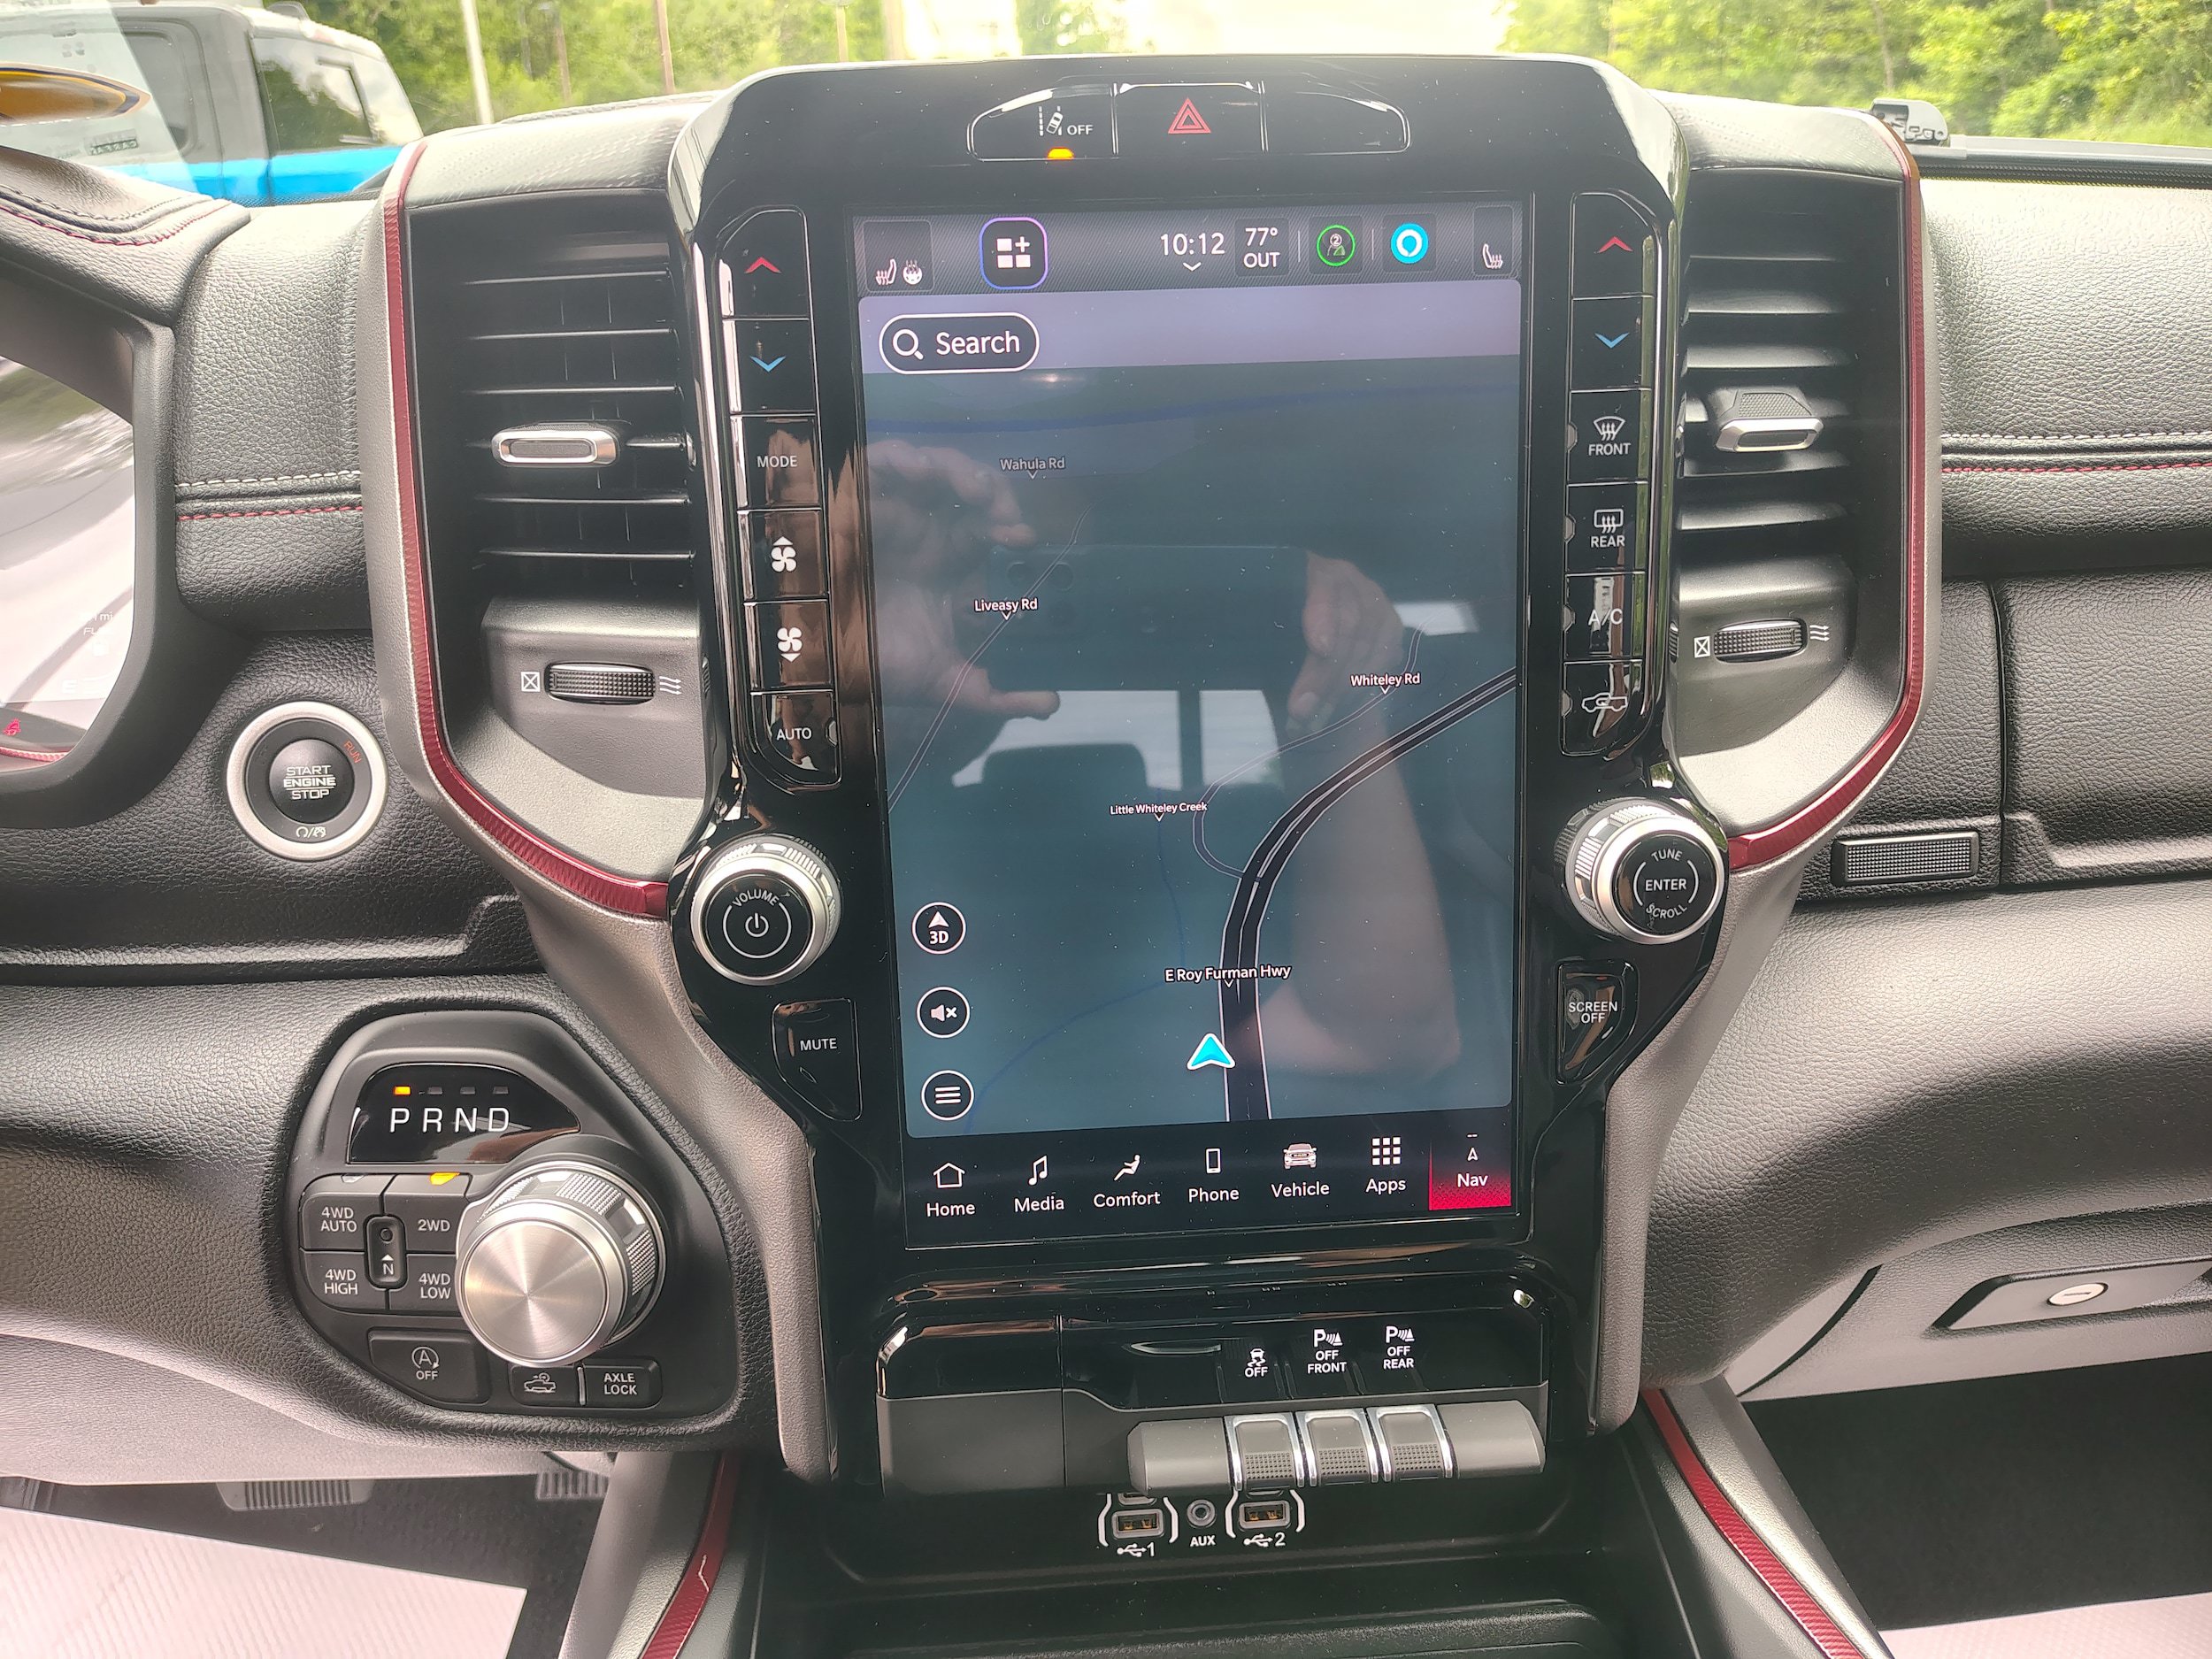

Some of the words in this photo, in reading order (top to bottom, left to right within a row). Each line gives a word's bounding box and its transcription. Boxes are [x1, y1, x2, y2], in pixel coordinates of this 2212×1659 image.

[1066, 124, 1094, 136] OFF
[1244, 227, 1279, 247] 77°
[1159, 232, 1226, 257] 10:12
[1243, 252, 1280, 269] OUT
[935, 330, 1021, 356] Search
[1587, 442, 1632, 457] FRONT
[757, 455, 798, 468] MODE
[1000, 457, 1046, 471] Wahula
[1048, 457, 1066, 469] Rd
[1590, 535, 1626, 549] REAR
[974, 599, 1019, 613] Liveasy
[1021, 597, 1038, 611] Rd
[1587, 608, 1624, 626] A/C
[1350, 674, 1402, 687] Whiteley
[1404, 672, 1420, 685] Rd
[776, 726, 812, 741] AUTO
[343, 740, 362, 764] RUN
[286, 764, 332, 776] START
[283, 776, 337, 788] ENGINE
[290, 788, 330, 800] STOP
[1110, 804, 1134, 815] Little
[1135, 803, 1178, 816] Whiteley
[1179, 802, 1208, 812] Creek
[1651, 848, 1683, 863] TUNE
[1645, 878, 1687, 892] ENTER
[732, 887, 780, 909] VOLUME
[1646, 902, 1688, 920] SCROLL
[929, 931, 949, 945] 3D
[1165, 972, 1173, 982] E
[1176, 970, 1203, 986] Roy
[1205, 968, 1257, 981] Furman
[1260, 965, 1292, 981] Hwy
[1568, 1001, 1618, 1014] SCREEN
[1580, 1012, 1606, 1024] OFF
[799, 1037, 838, 1051] MUTE
[1365, 1178, 1407, 1196] Apps
[1456, 1173, 1488, 1188] Nav
[1188, 1187, 1240, 1203] Phone
[1271, 1180, 1330, 1198] Vehicle
[1014, 1196, 1065, 1212] Media
[1093, 1190, 1161, 1209] Comfort
[321, 1206, 354, 1219] 4WD
[926, 1202, 976, 1217] Home
[320, 1219, 357, 1233] AUTO
[417, 1218, 450, 1233] 2WD
[325, 1270, 357, 1282] 4WD
[382, 1262, 395, 1276] N
[419, 1272, 451, 1286] 4WD
[324, 1281, 358, 1296] HIGH
[419, 1286, 452, 1301] LOW
[1315, 1350, 1339, 1361] OFF
[1386, 1345, 1410, 1357] OFF
[1307, 1361, 1347, 1374] FRONT
[1383, 1357, 1415, 1370] REAR
[416, 1369, 439, 1380] OFF
[603, 1371, 635, 1383] AXLE
[1244, 1365, 1269, 1378] OFF
[603, 1383, 637, 1396] LOCK
[1189, 1535, 1216, 1548] AUX
[1274, 1532, 1286, 1547] 2
[1148, 1542, 1156, 1556] 1
